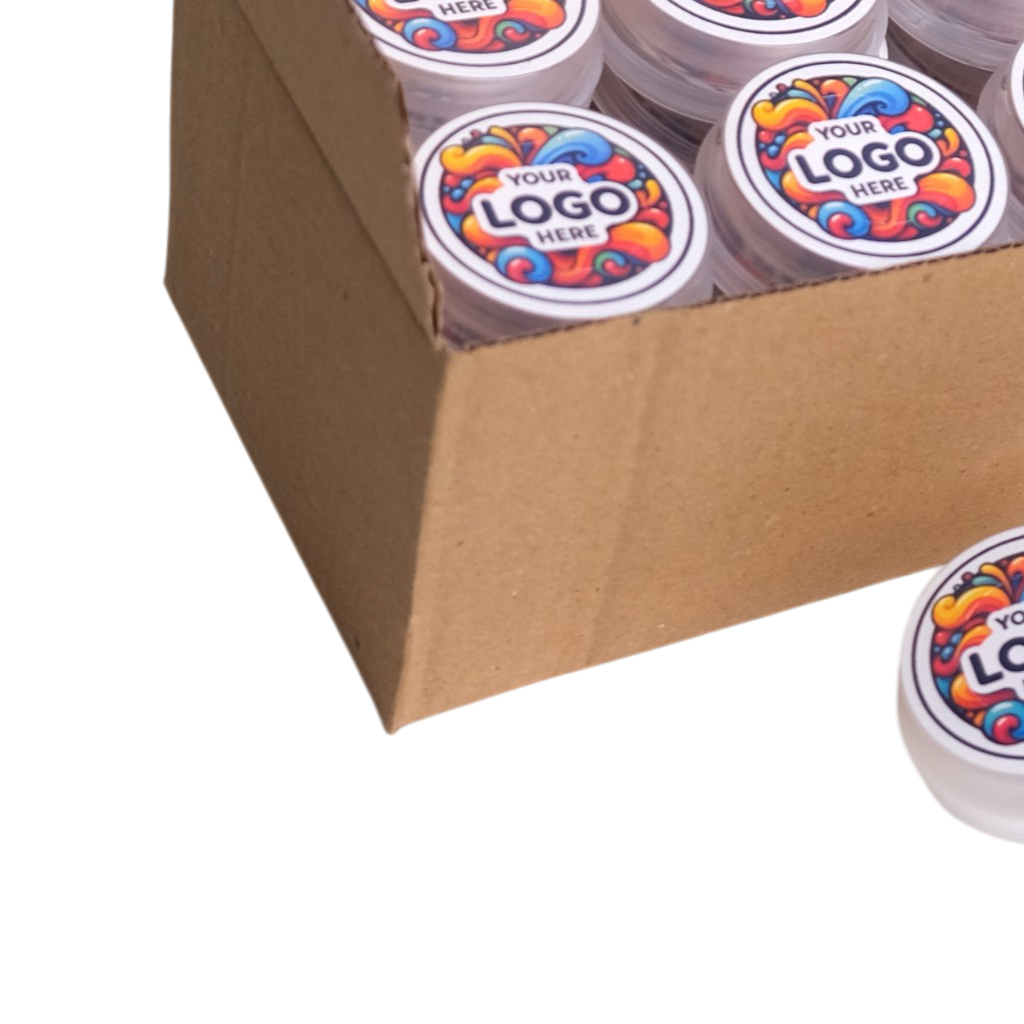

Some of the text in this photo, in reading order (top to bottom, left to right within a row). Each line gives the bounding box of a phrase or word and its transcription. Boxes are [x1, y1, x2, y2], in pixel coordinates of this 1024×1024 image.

[815, 120, 876, 140] YOUR
[794, 136, 934, 185] LOGO
[507, 169, 571, 186] YOUR
[850, 176, 908, 198] HERE
[480, 186, 631, 229] LOGO
[536, 225, 597, 244] HERE
